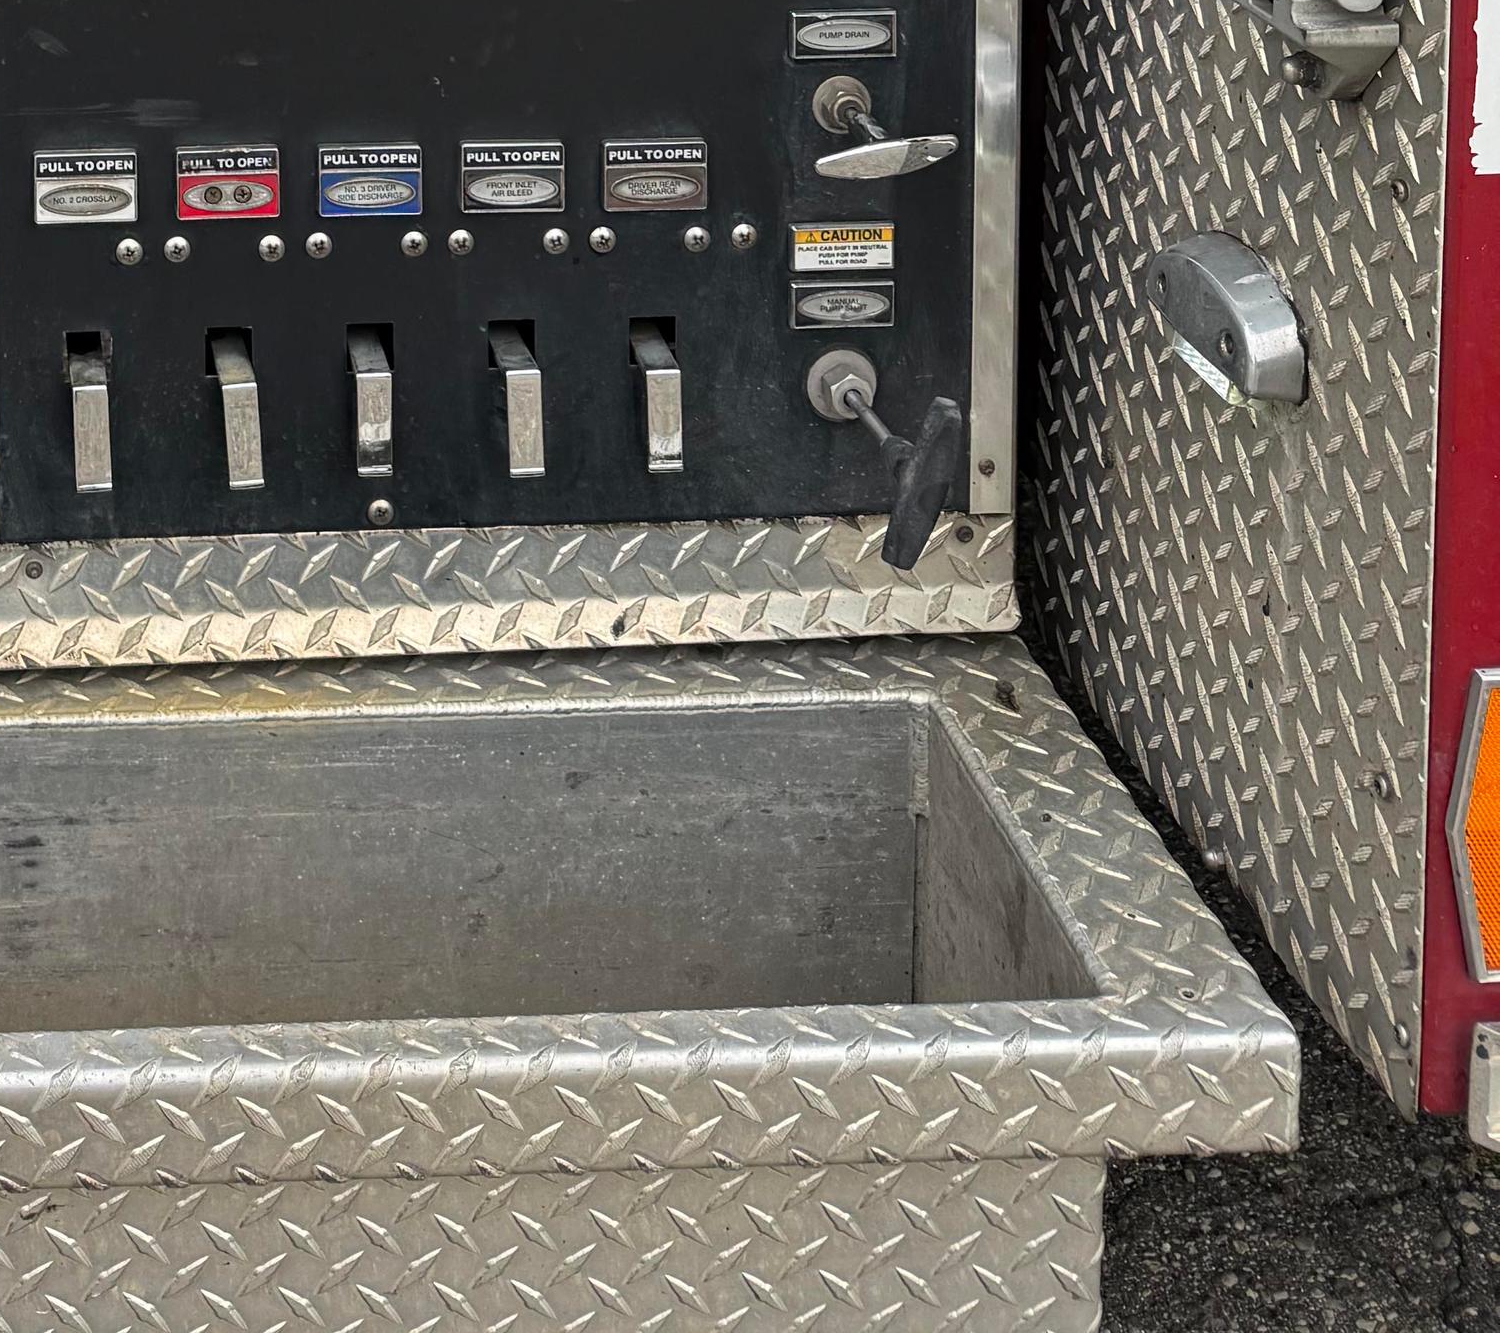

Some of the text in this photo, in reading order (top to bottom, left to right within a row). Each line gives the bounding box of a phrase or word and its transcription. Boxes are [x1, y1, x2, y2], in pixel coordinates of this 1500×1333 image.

[818, 30, 870, 39] PUMP DRAIN
[608, 148, 702, 161] PULL TO OPEN
[39, 159, 134, 173] PULL TO OPEN
[820, 229, 883, 242] CAUTION
